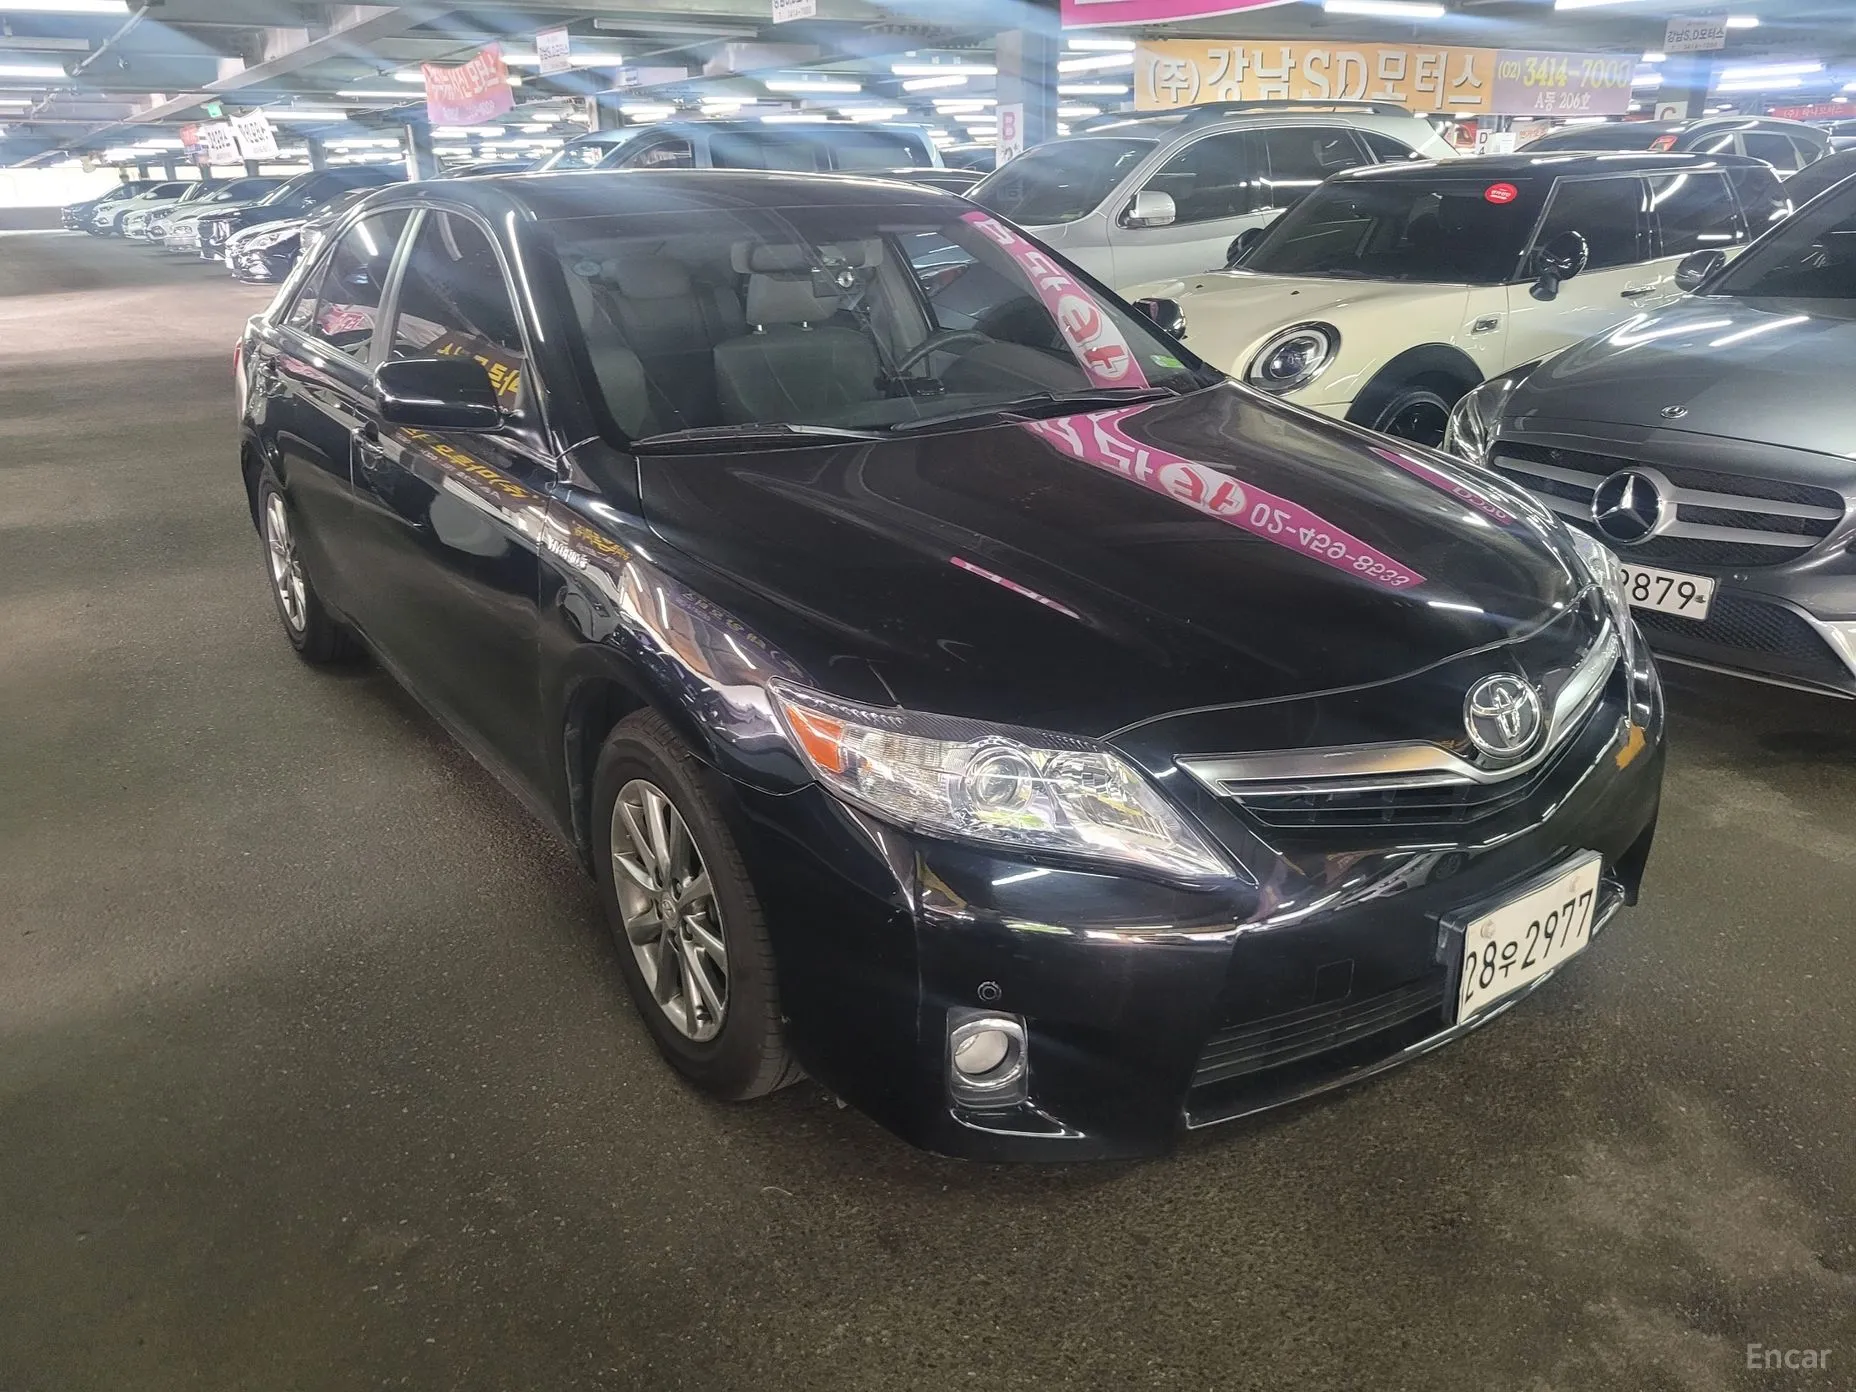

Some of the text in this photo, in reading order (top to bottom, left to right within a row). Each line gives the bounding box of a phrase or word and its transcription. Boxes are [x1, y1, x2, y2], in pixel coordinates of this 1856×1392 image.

[1523, 56, 1631, 88] 3414-7000
[1534, 91, 1591, 111] A동 206호
[1479, 132, 1488, 144] D
[1464, 888, 1593, 1004] 28우2977
